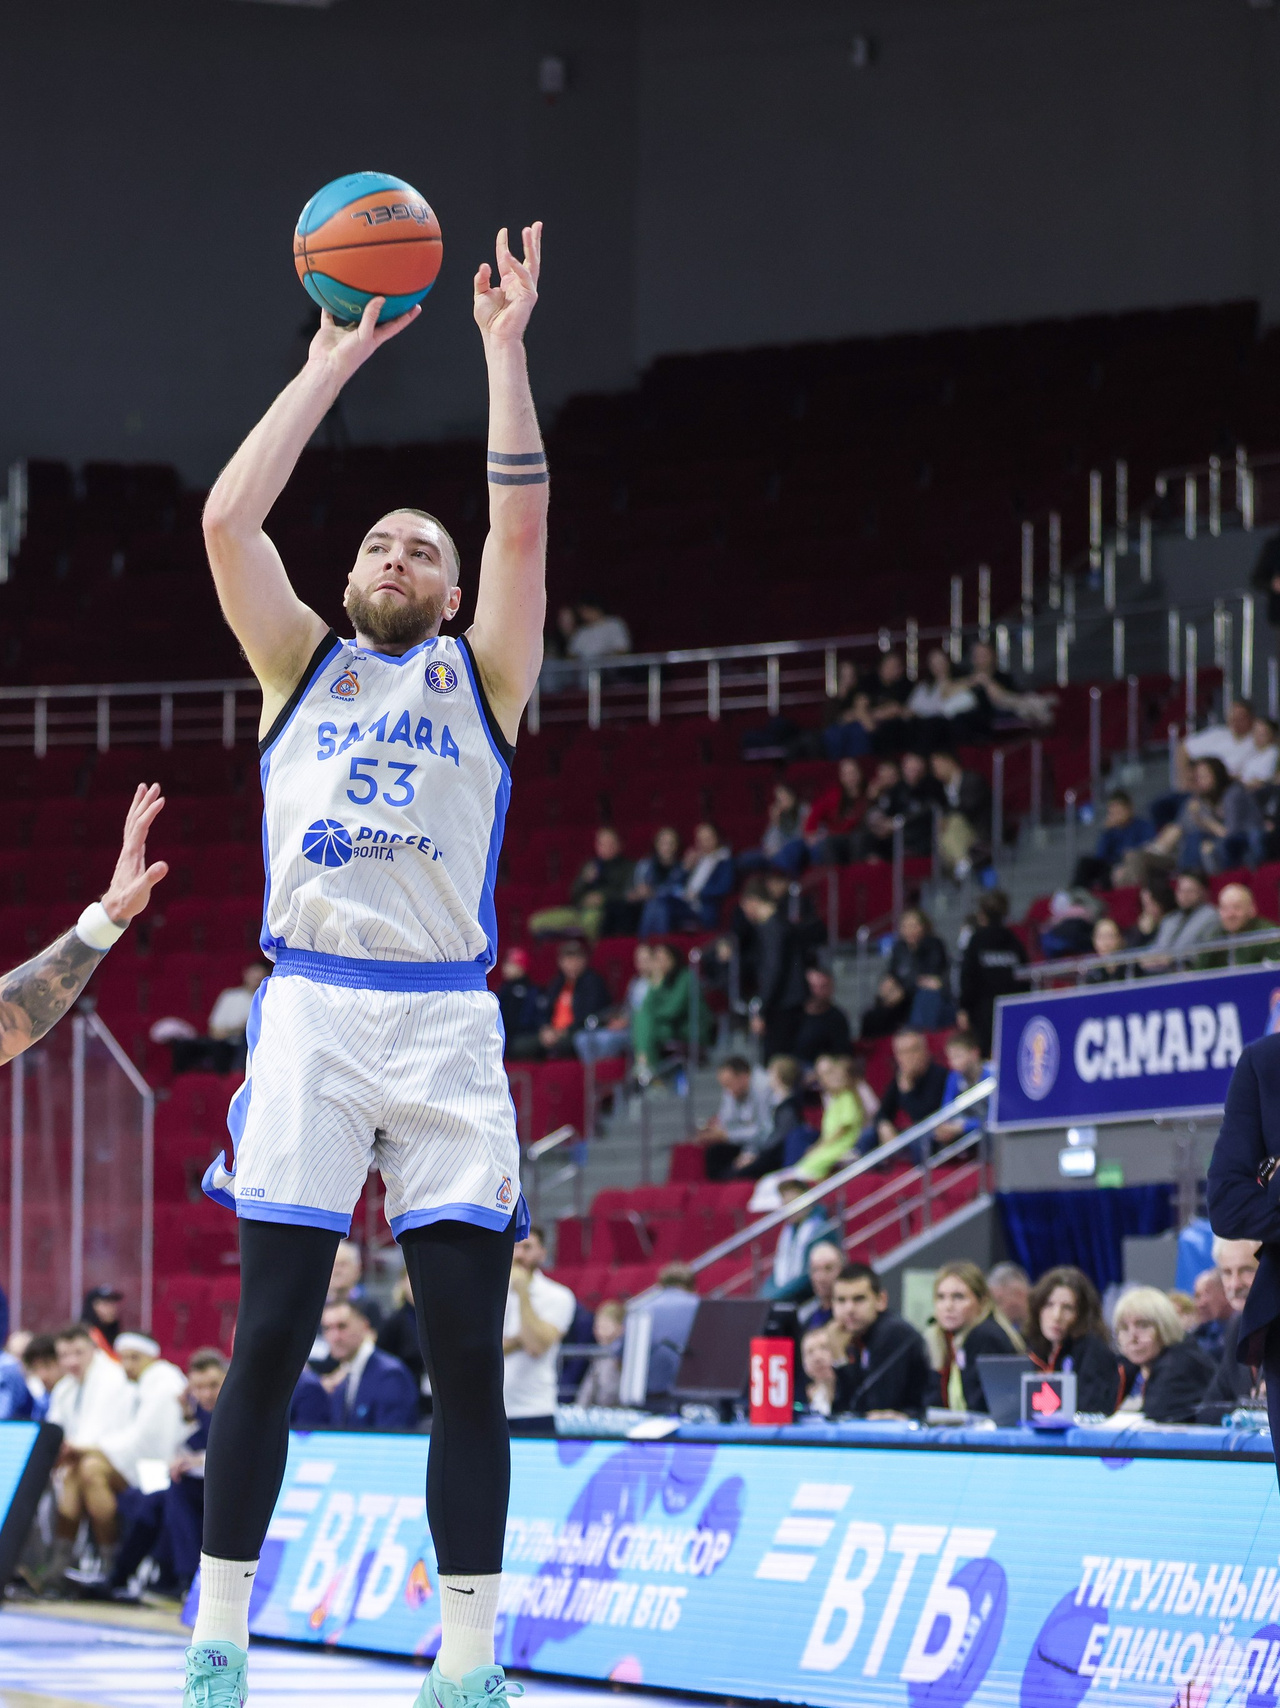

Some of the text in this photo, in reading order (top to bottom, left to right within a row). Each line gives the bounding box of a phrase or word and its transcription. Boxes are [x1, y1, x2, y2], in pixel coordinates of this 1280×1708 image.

[317, 709, 460, 767] SAMARA
[346, 757, 418, 808] 53
[353, 846, 394, 862] ВОЛГА
[1073, 1002, 1243, 1083] САМАРА
[240, 1187, 265, 1198] ZEDO
[290, 1492, 426, 1620] ВТБ
[607, 1524, 732, 1576] СПОНСОР
[632, 1583, 688, 1630] ВТБ
[800, 1521, 997, 1683] ВТБ
[1074, 1555, 1280, 1623] ТИТУЛЬНЫЙ
[1078, 1621, 1235, 1690] ЕДИНОЙ
